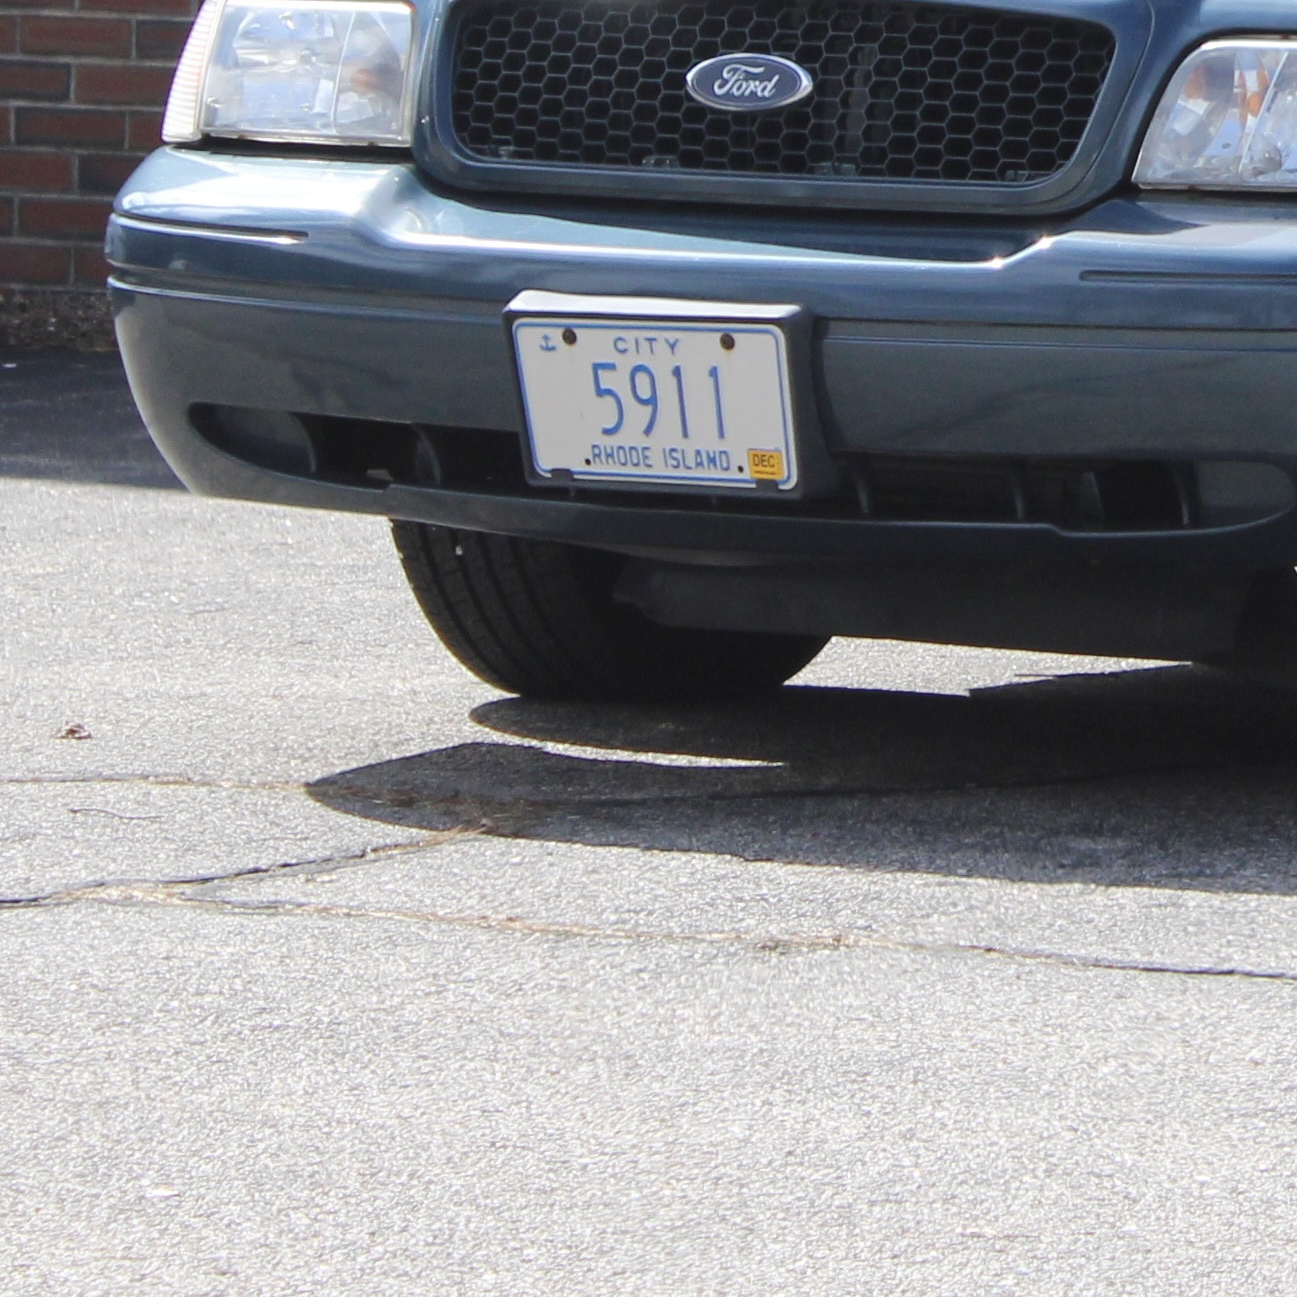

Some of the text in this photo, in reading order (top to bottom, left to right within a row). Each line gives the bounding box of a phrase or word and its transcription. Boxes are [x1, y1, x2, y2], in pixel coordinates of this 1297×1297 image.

[713, 63, 780, 98] Ford
[613, 336, 679, 355] CITY
[591, 362, 725, 439] 5911
[591, 444, 731, 471] RHODE ISLAND
[752, 453, 775, 468] DEC
